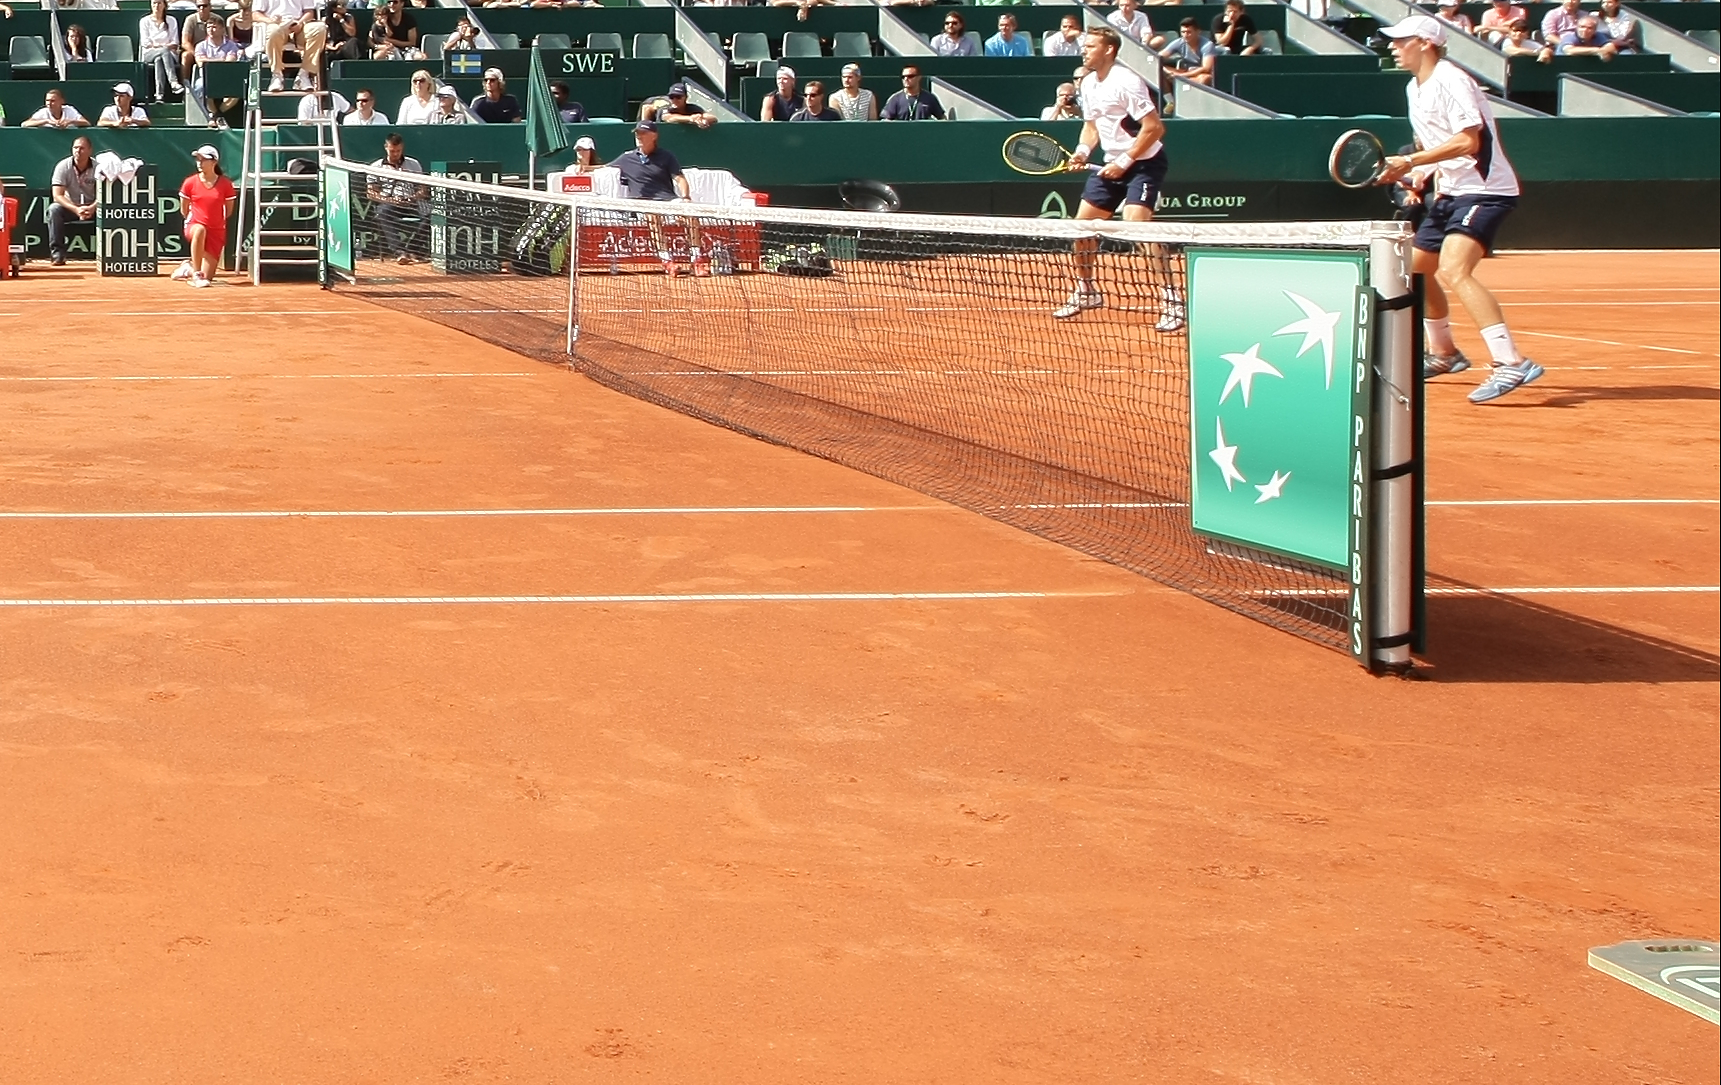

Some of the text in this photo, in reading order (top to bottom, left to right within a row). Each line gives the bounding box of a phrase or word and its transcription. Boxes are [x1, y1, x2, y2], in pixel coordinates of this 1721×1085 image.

[562, 53, 614, 73] SWE
[1186, 193, 1246, 208] GROUP
[106, 209, 155, 219] HOTELES
[293, 236, 311, 245] by
[106, 262, 155, 273] HOTELES
[450, 260, 499, 270] HOTELES
[1352, 293, 1368, 656] BNP PARIBAS
